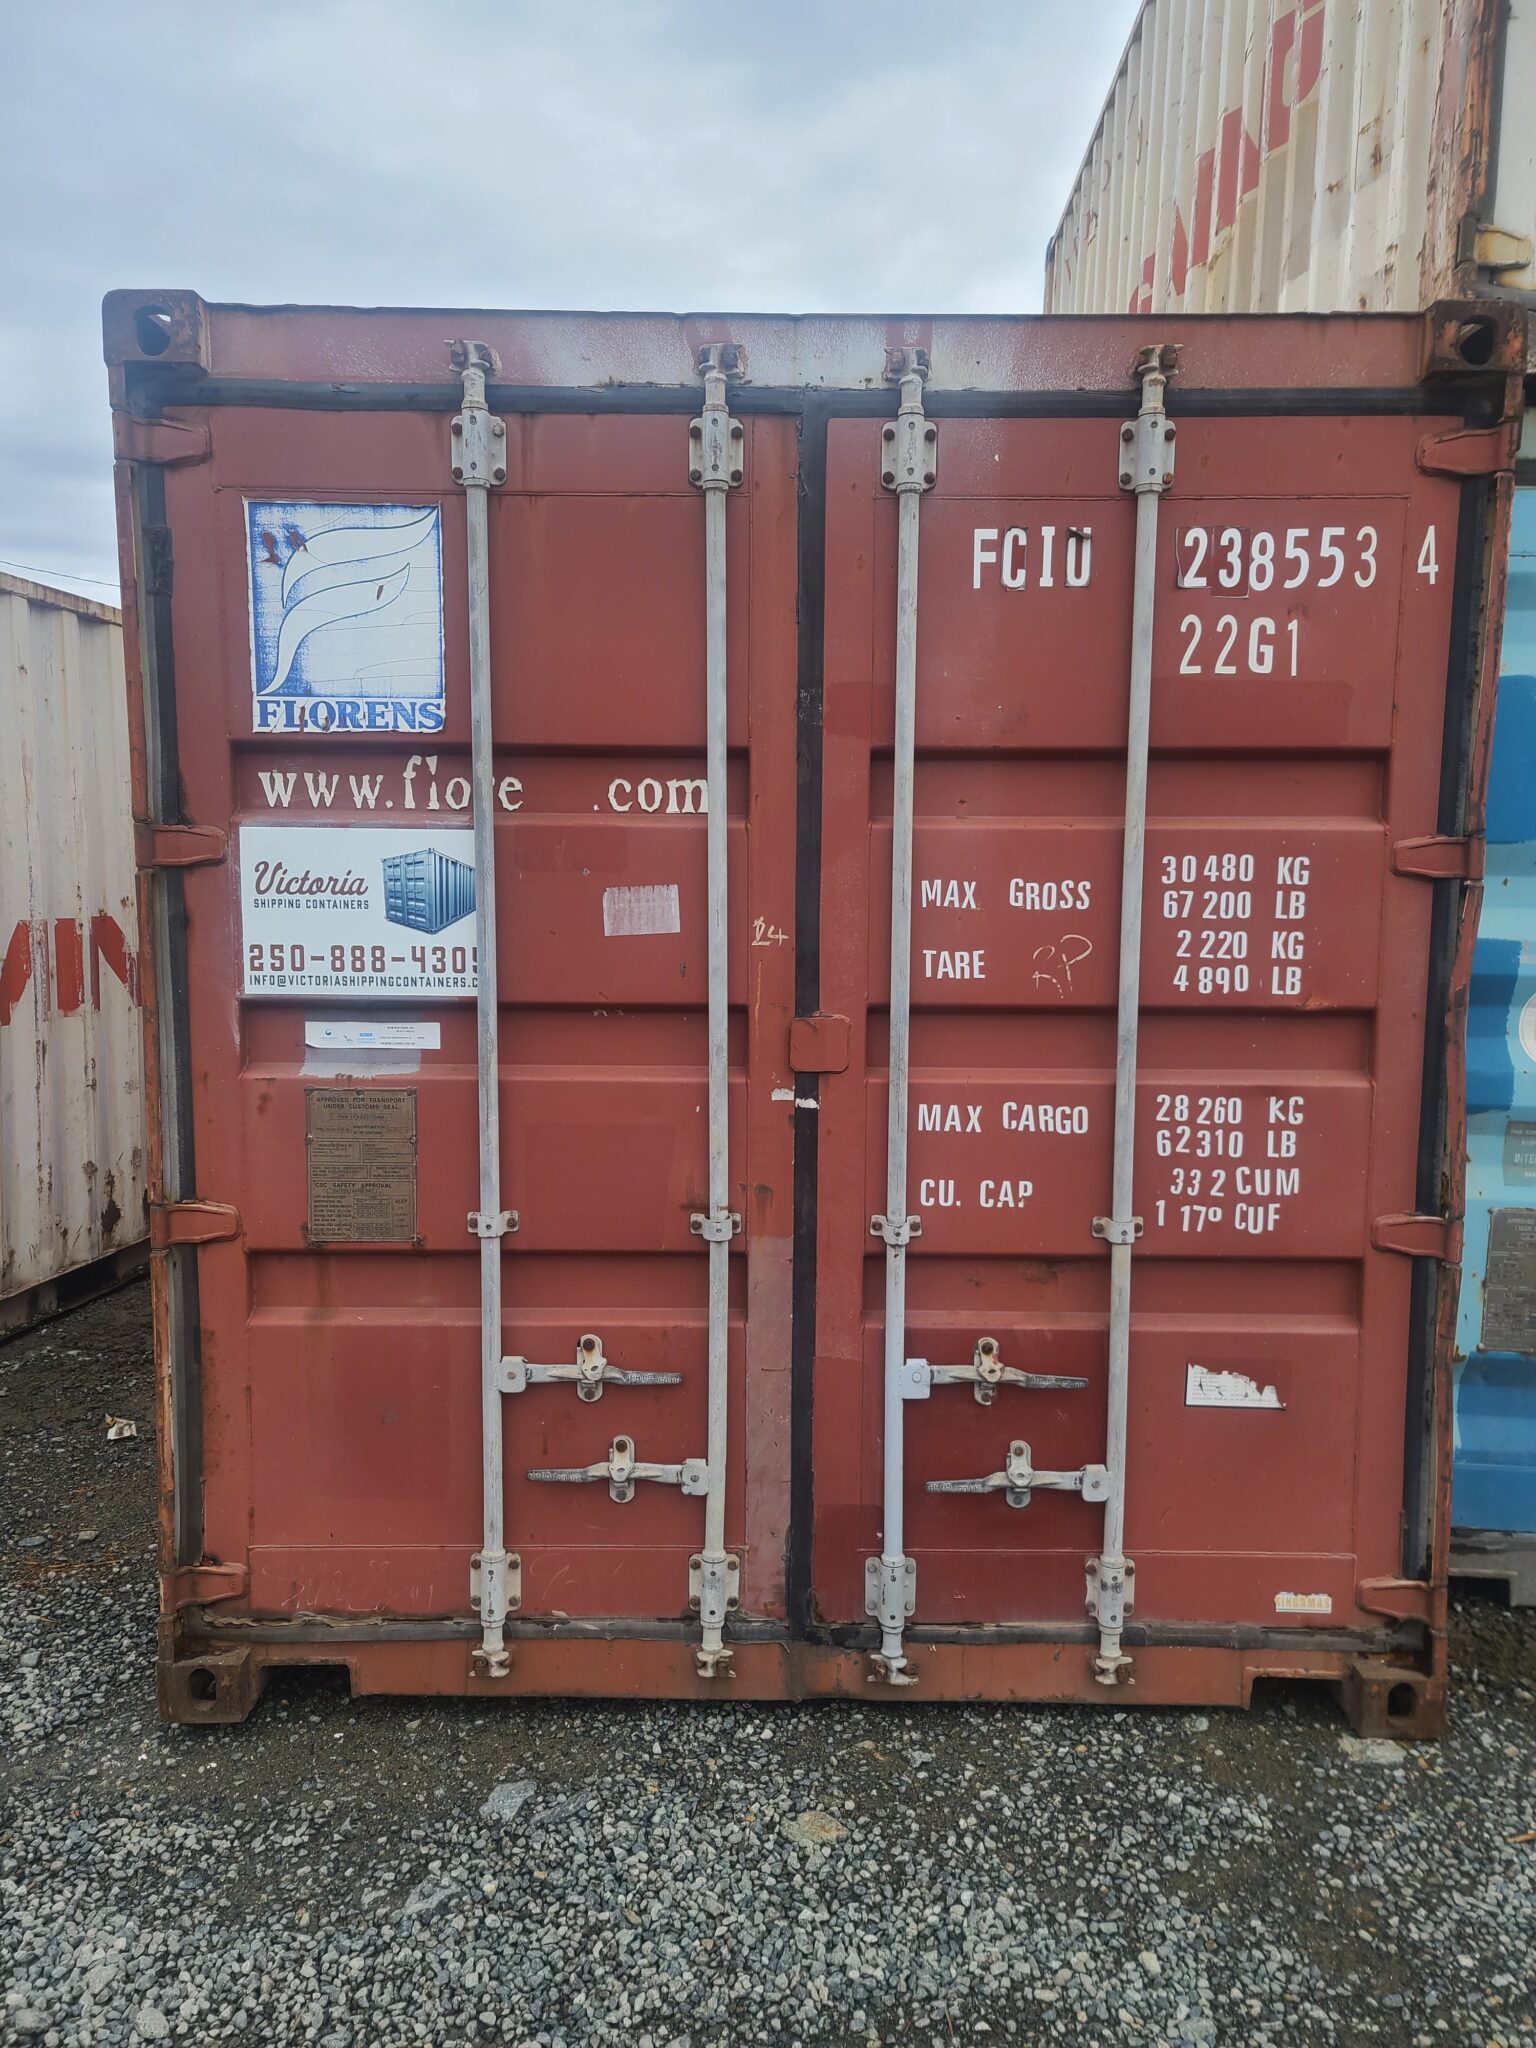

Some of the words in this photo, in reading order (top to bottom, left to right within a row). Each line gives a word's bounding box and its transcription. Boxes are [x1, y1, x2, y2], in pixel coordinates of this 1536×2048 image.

[973, 526, 1092, 589] FCIU
[1183, 526, 1378, 591] 238553
[1417, 524, 1439, 585] 4
[1179, 614, 1298, 677] 22G1
[257, 700, 445, 730] FLORENS
[254, 860, 369, 896] Victoria
[1276, 856, 1310, 886] KG
[253, 898, 301, 909] SHIPPING
[306, 899, 369, 910] CONTAINERS
[921, 878, 977, 909] MAX
[1009, 878, 1092, 911] GROSS
[1275, 890, 1306, 919] LB
[1271, 930, 1305, 960] KG
[922, 949, 986, 980] TARE
[1271, 966, 1302, 995] LB
[917, 1103, 983, 1133] MAX
[1002, 1101, 1089, 1135] CARGO
[1269, 1096, 1305, 1125] KG
[1267, 1130, 1296, 1158] LB
[1513, 1152, 1536, 1165] INTE
[920, 1178, 961, 1207] CU.
[979, 1179, 1033, 1208] CAP
[1235, 1166, 1300, 1196] CUM
[1234, 1202, 1281, 1234] CUF
